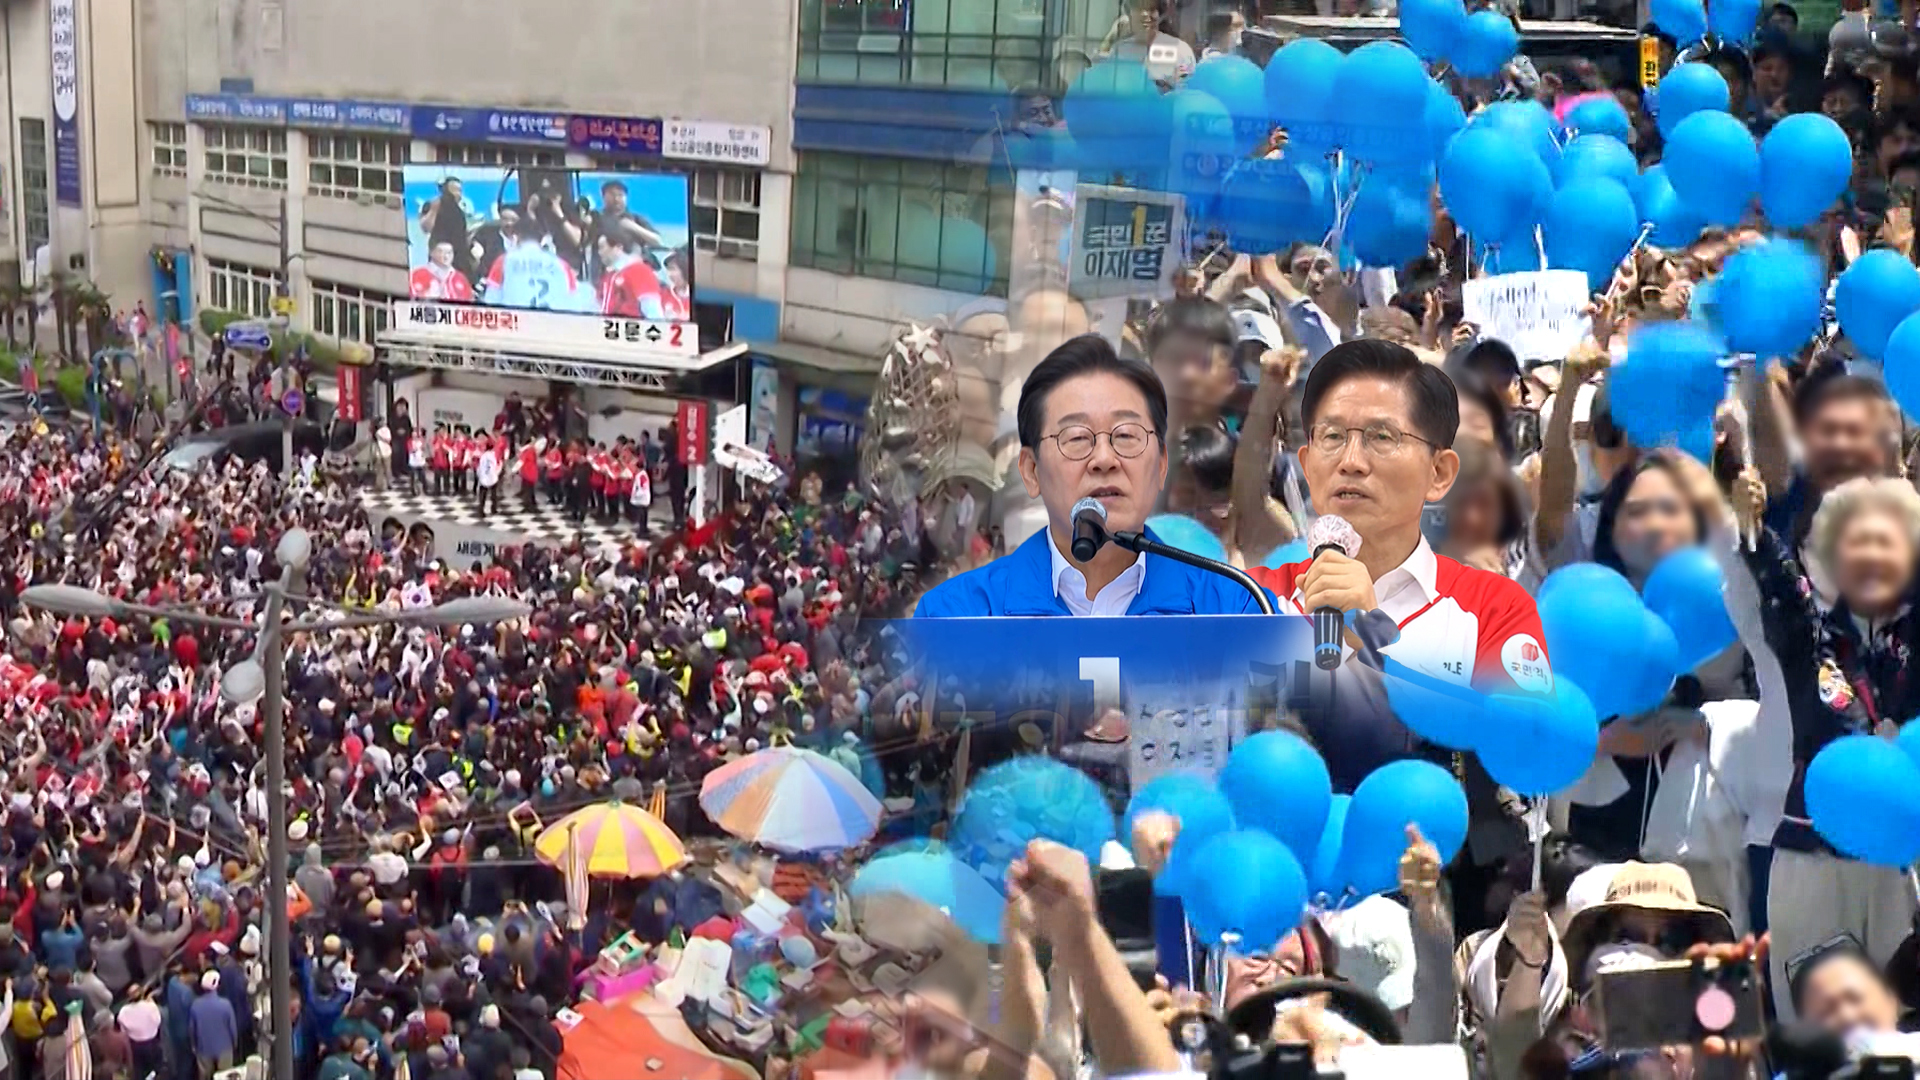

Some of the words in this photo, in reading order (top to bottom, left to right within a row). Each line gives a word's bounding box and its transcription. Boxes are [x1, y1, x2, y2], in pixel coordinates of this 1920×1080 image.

[1085, 247, 1164, 280] 이재명
[603, 320, 662, 342] 김문수
[669, 324, 683, 347] 2
[687, 444, 697, 461] 2
